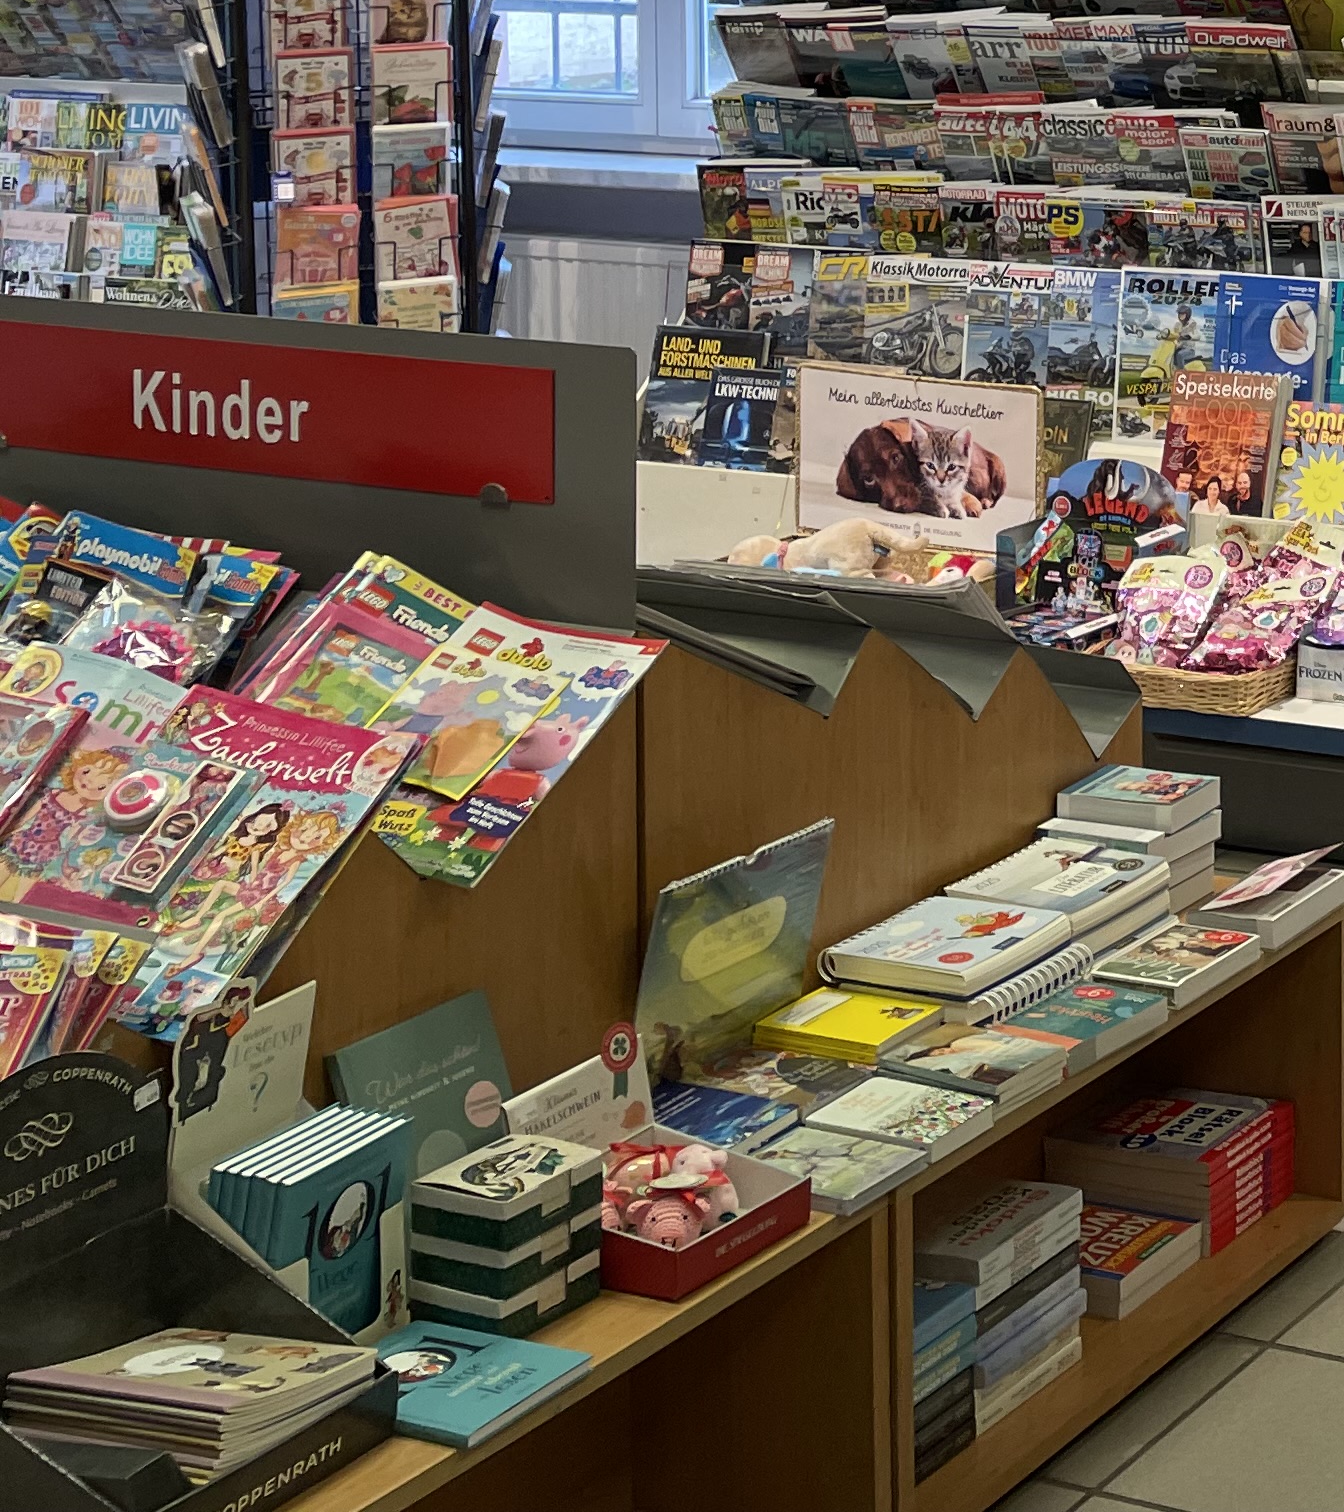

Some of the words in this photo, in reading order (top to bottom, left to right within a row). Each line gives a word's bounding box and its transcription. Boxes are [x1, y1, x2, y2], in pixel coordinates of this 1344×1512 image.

[1193, 31, 1288, 49] Quadwelt
[659, 351, 756, 370] FORSTMASCHINEN
[662, 336, 696, 351] LAND-
[699, 338, 721, 353] UND
[828, 387, 858, 405] Mein
[864, 392, 932, 413] allerliebstes
[936, 398, 1005, 420] Kuscheltier
[1174, 374, 1275, 401] Speisekarte
[131, 368, 309, 444] Kinder
[1305, 431, 1315, 444] in
[75, 540, 162, 585] playmobil
[192, 704, 353, 786] Zauberwelt
[52, 1066, 133, 1098] COPPENRATH
[41, 1163, 79, 1193] FÜR
[83, 1136, 137, 1173] DICH
